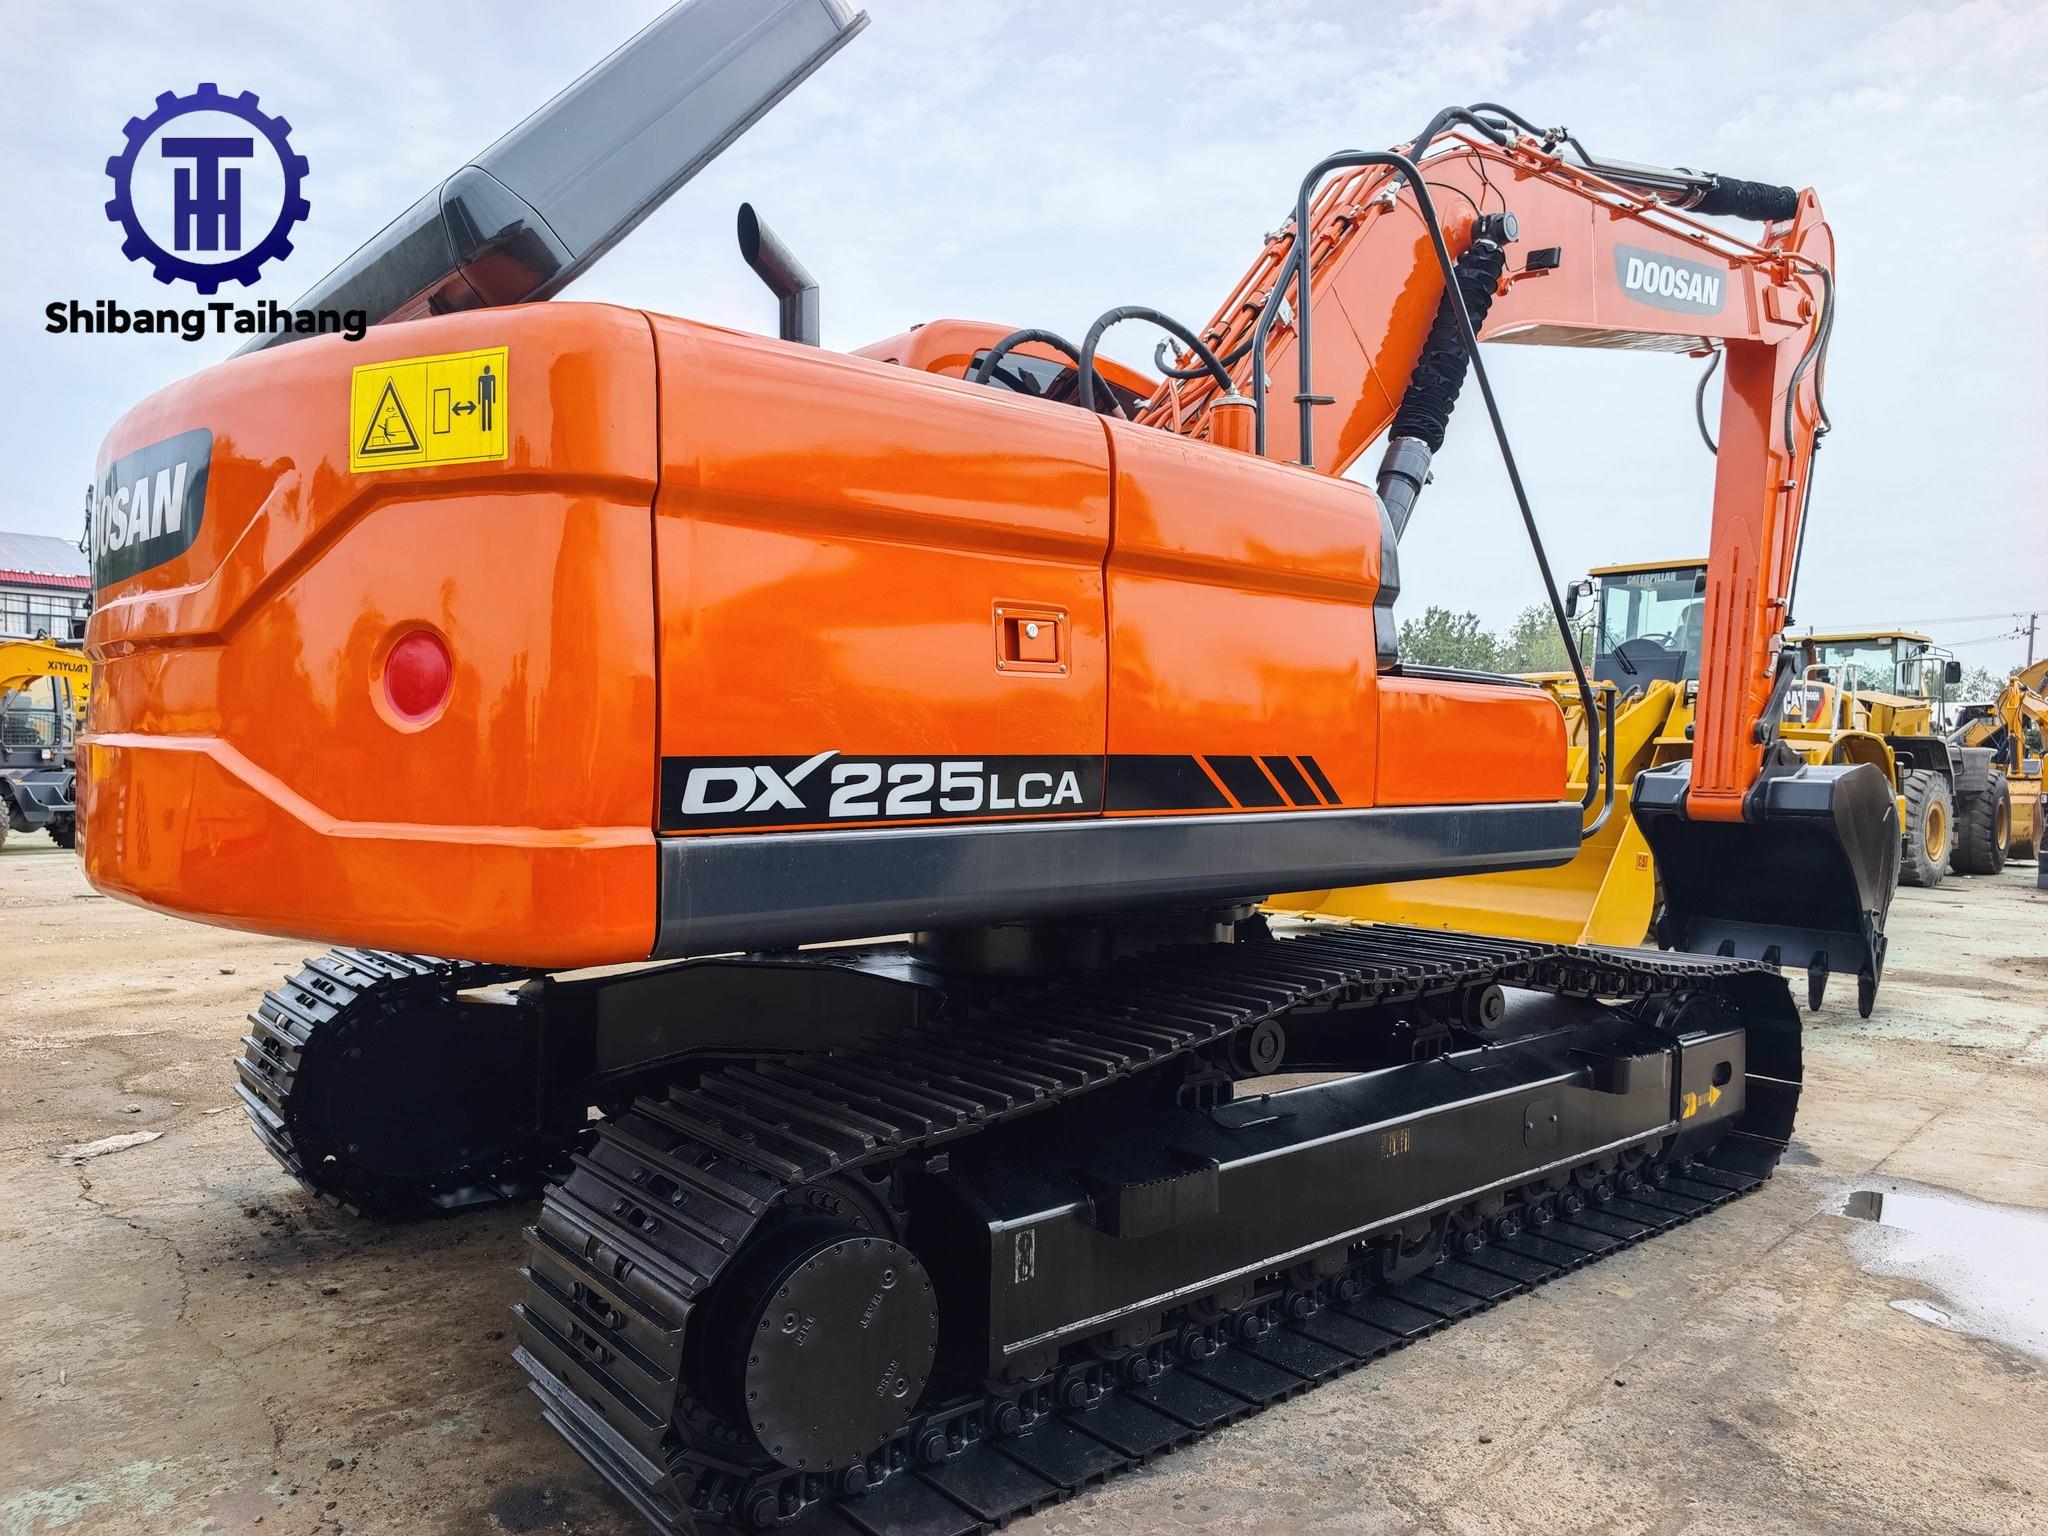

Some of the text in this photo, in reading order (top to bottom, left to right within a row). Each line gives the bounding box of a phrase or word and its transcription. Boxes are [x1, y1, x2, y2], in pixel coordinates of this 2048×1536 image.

[1626, 257, 1720, 306] DOOSAN
[91, 462, 188, 563] OOSAN
[1626, 571, 1677, 585] CATERPILLAR
[1783, 690, 1806, 715] CAT
[860, 1293, 884, 1329] LEVEL
[796, 1315, 817, 1347] FILL
[875, 1359, 899, 1397] DRAIN
